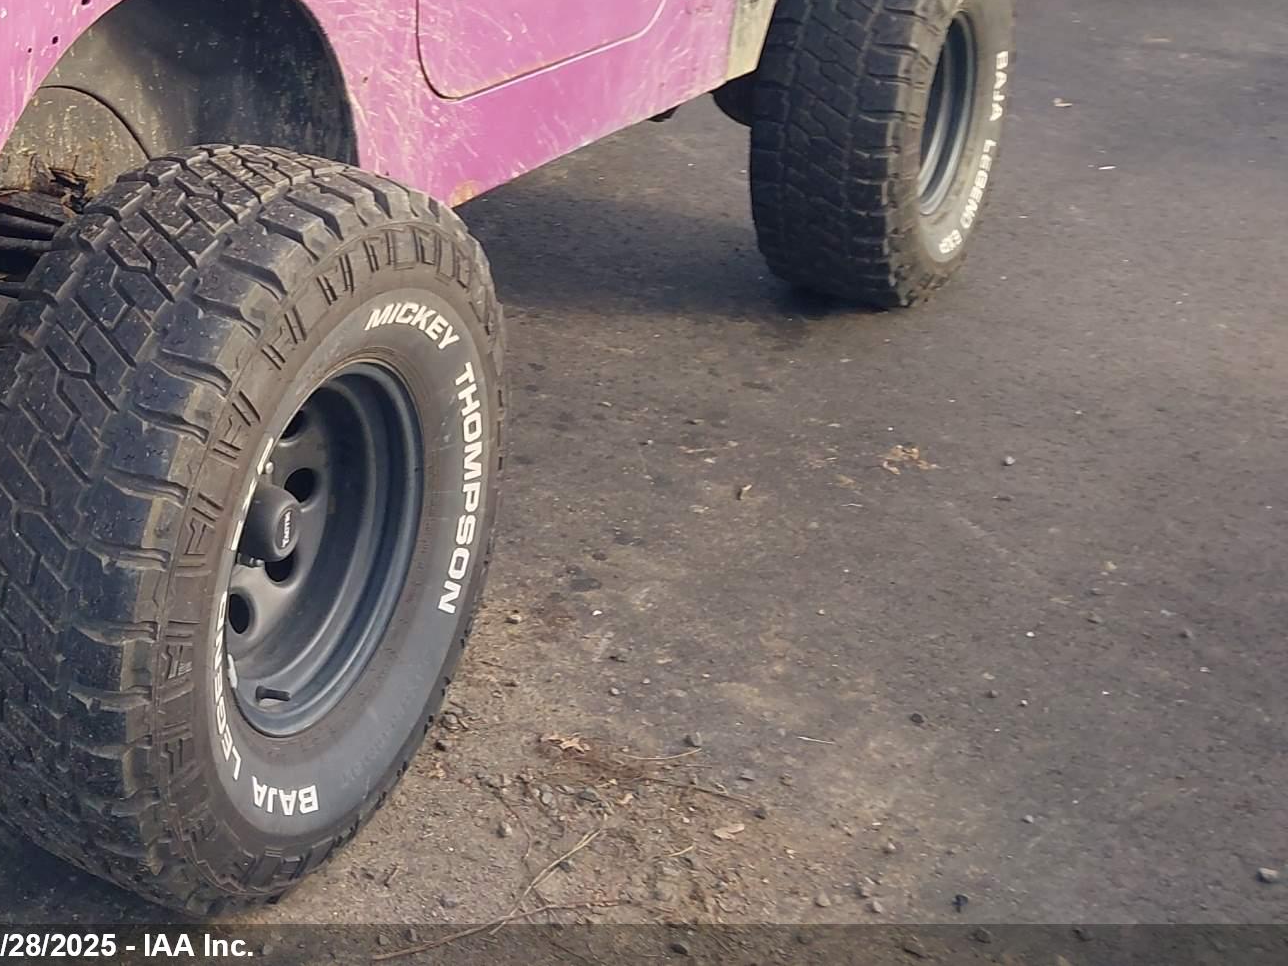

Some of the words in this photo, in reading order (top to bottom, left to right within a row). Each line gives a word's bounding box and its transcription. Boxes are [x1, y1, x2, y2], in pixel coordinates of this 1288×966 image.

[989, 51, 1008, 121] BAJA
[960, 139, 996, 229] LEGEND
[364, 302, 459, 350] MICKEY
[438, 361, 484, 614] THOMPSON
[214, 591, 241, 780] LEGEND
[252, 776, 319, 815] BAJA
